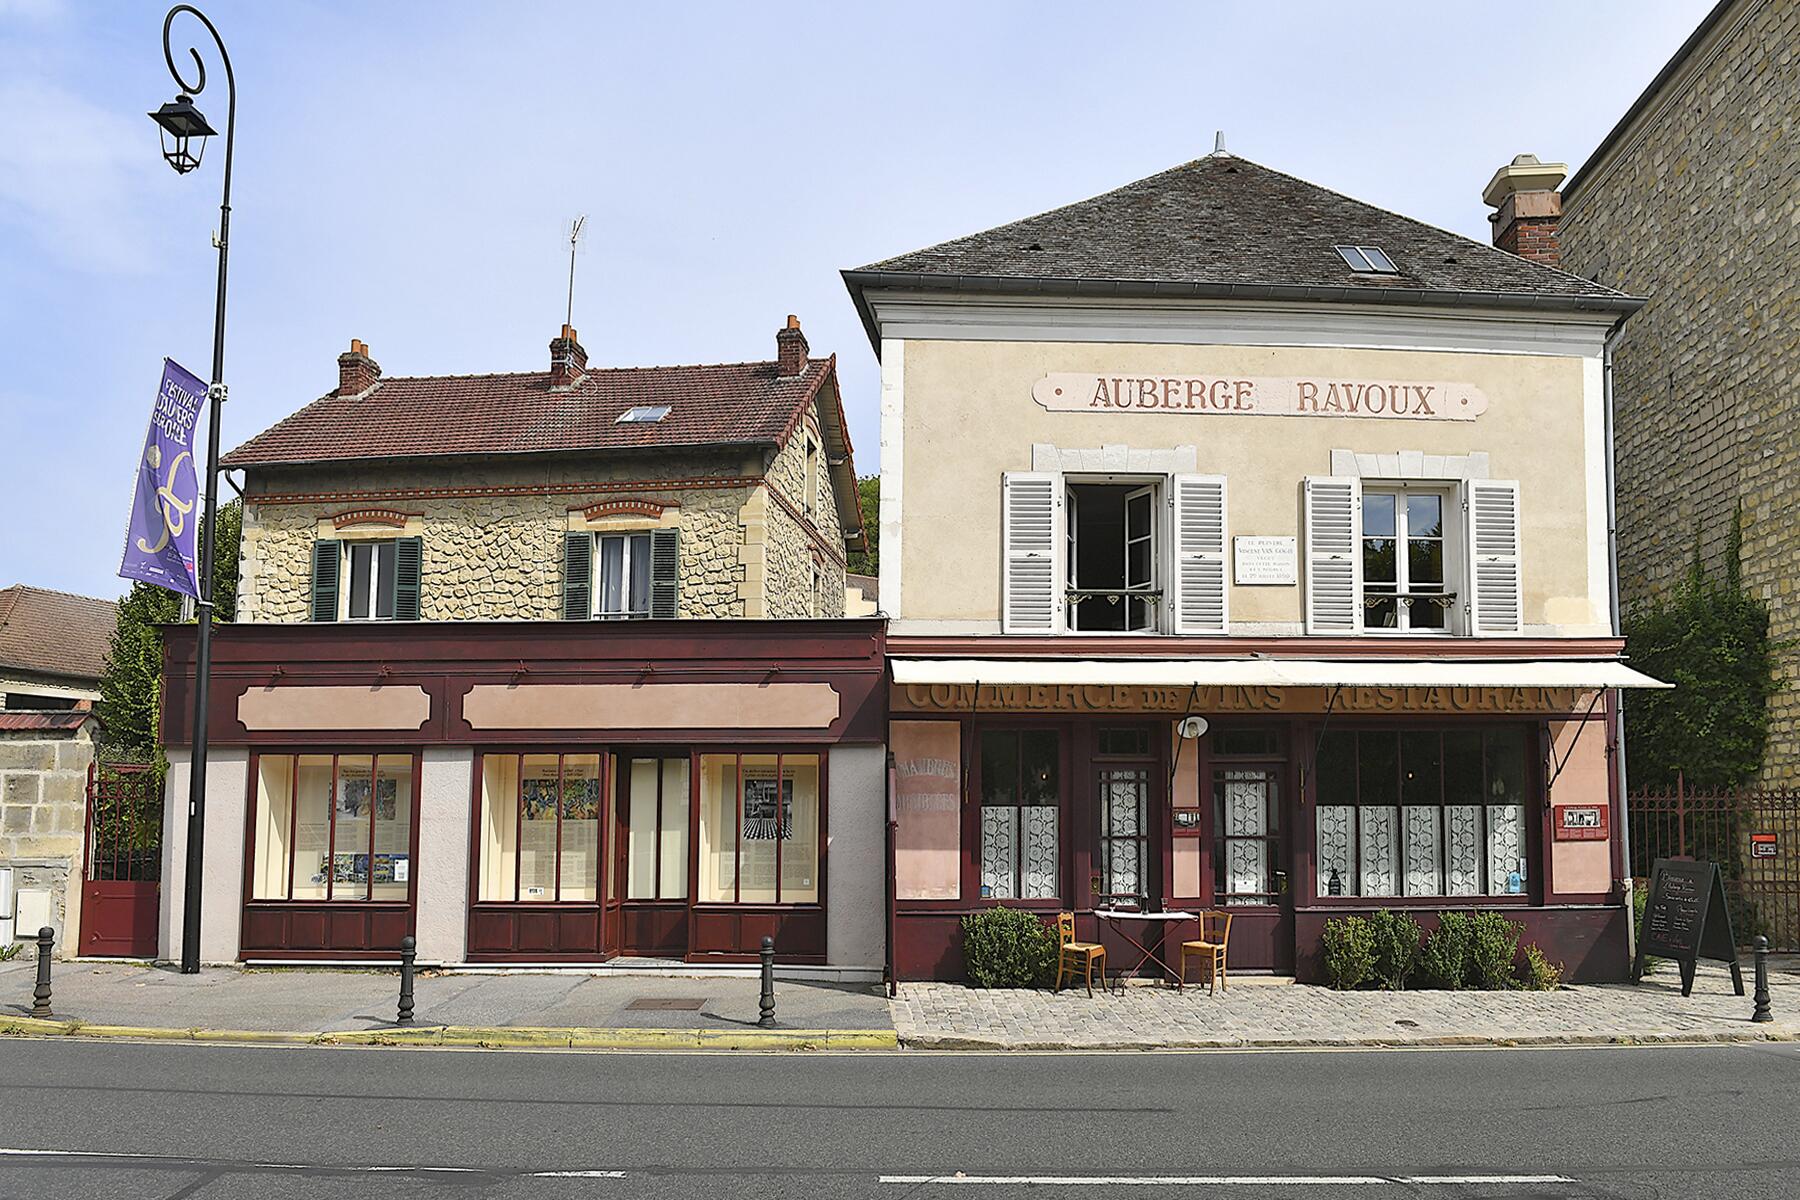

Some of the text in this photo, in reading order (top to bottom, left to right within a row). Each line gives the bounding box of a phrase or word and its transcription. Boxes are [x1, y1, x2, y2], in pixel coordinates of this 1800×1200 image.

[165, 378, 199, 414] FESTIVAL
[1088, 377, 1436, 416] AUBERGE RAVOUX
[906, 685, 1587, 712] COMMERCE DE VINS RESTAURANT
